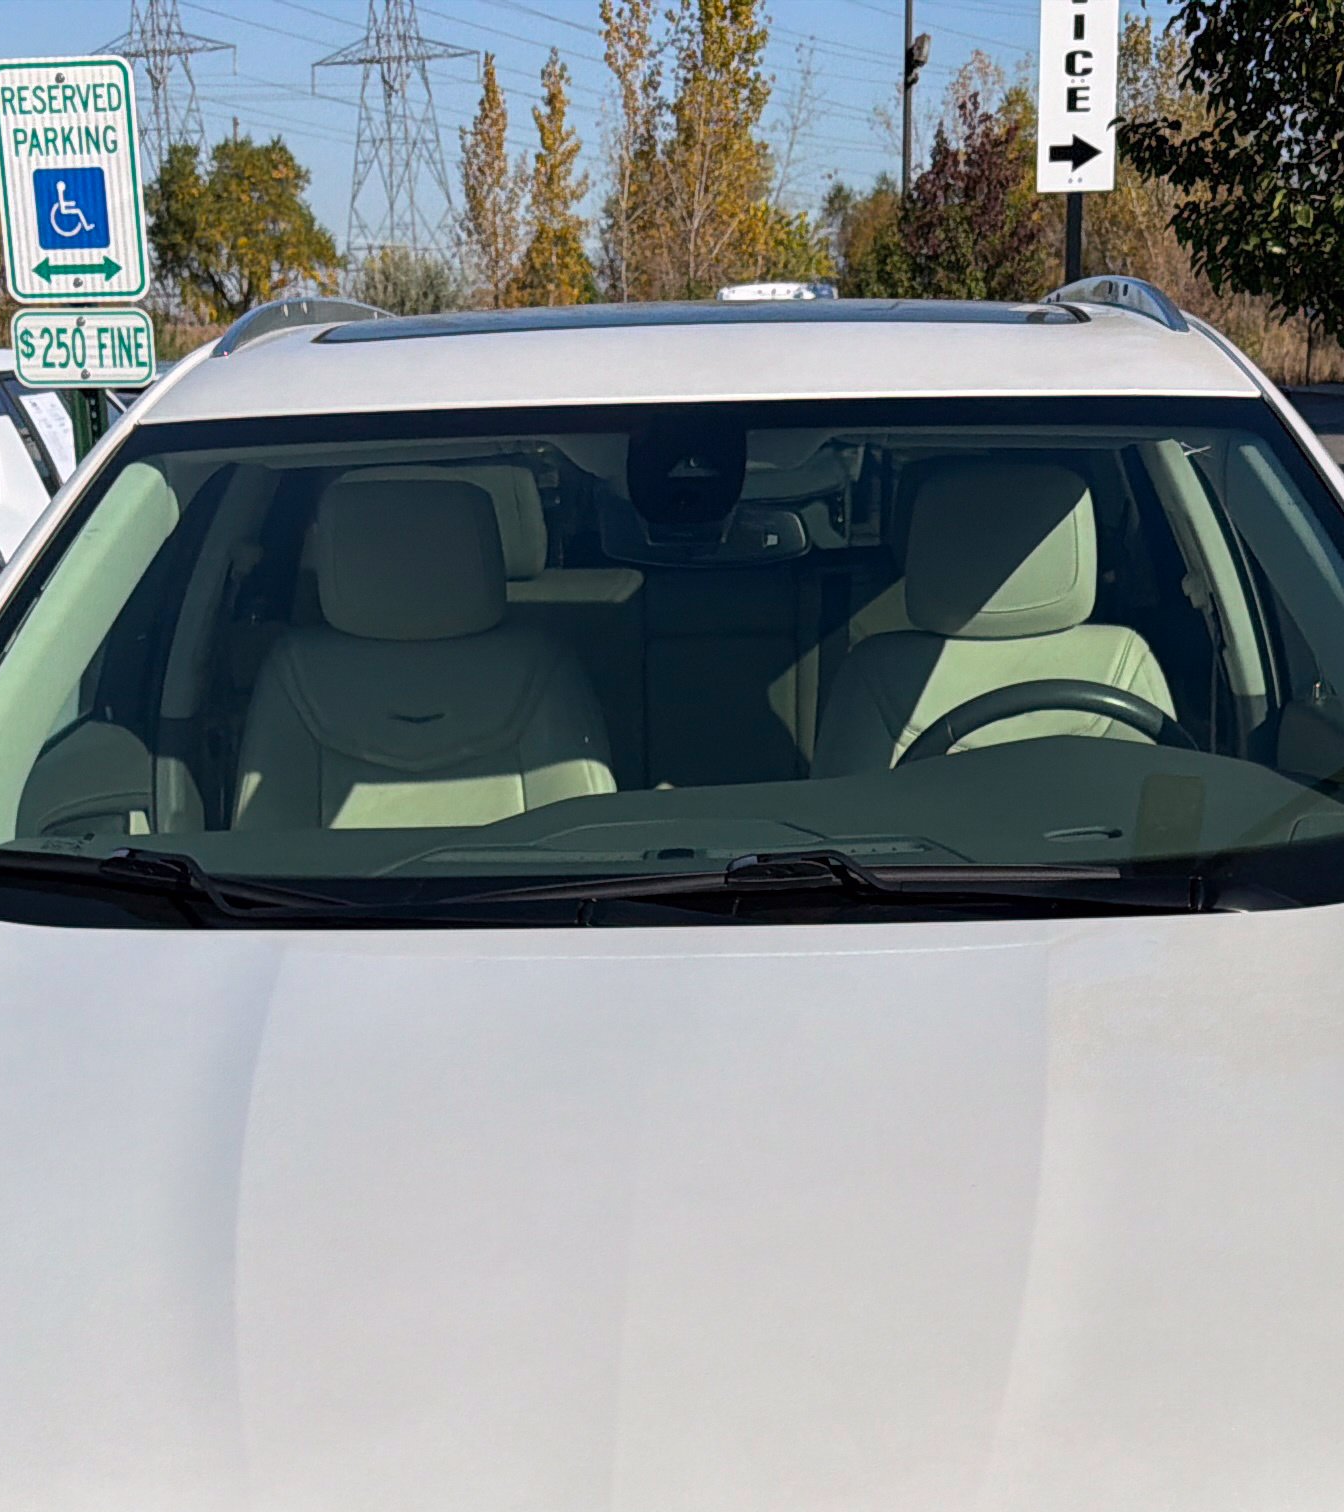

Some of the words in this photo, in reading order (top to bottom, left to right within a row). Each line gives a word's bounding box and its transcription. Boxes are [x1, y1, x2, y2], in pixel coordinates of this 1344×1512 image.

[1065, 0, 1094, 112] ICE
[0, 82, 122, 116] RESERVED
[13, 125, 118, 157] PARKING
[19, 327, 86, 369] $250
[97, 327, 148, 368] FINE
